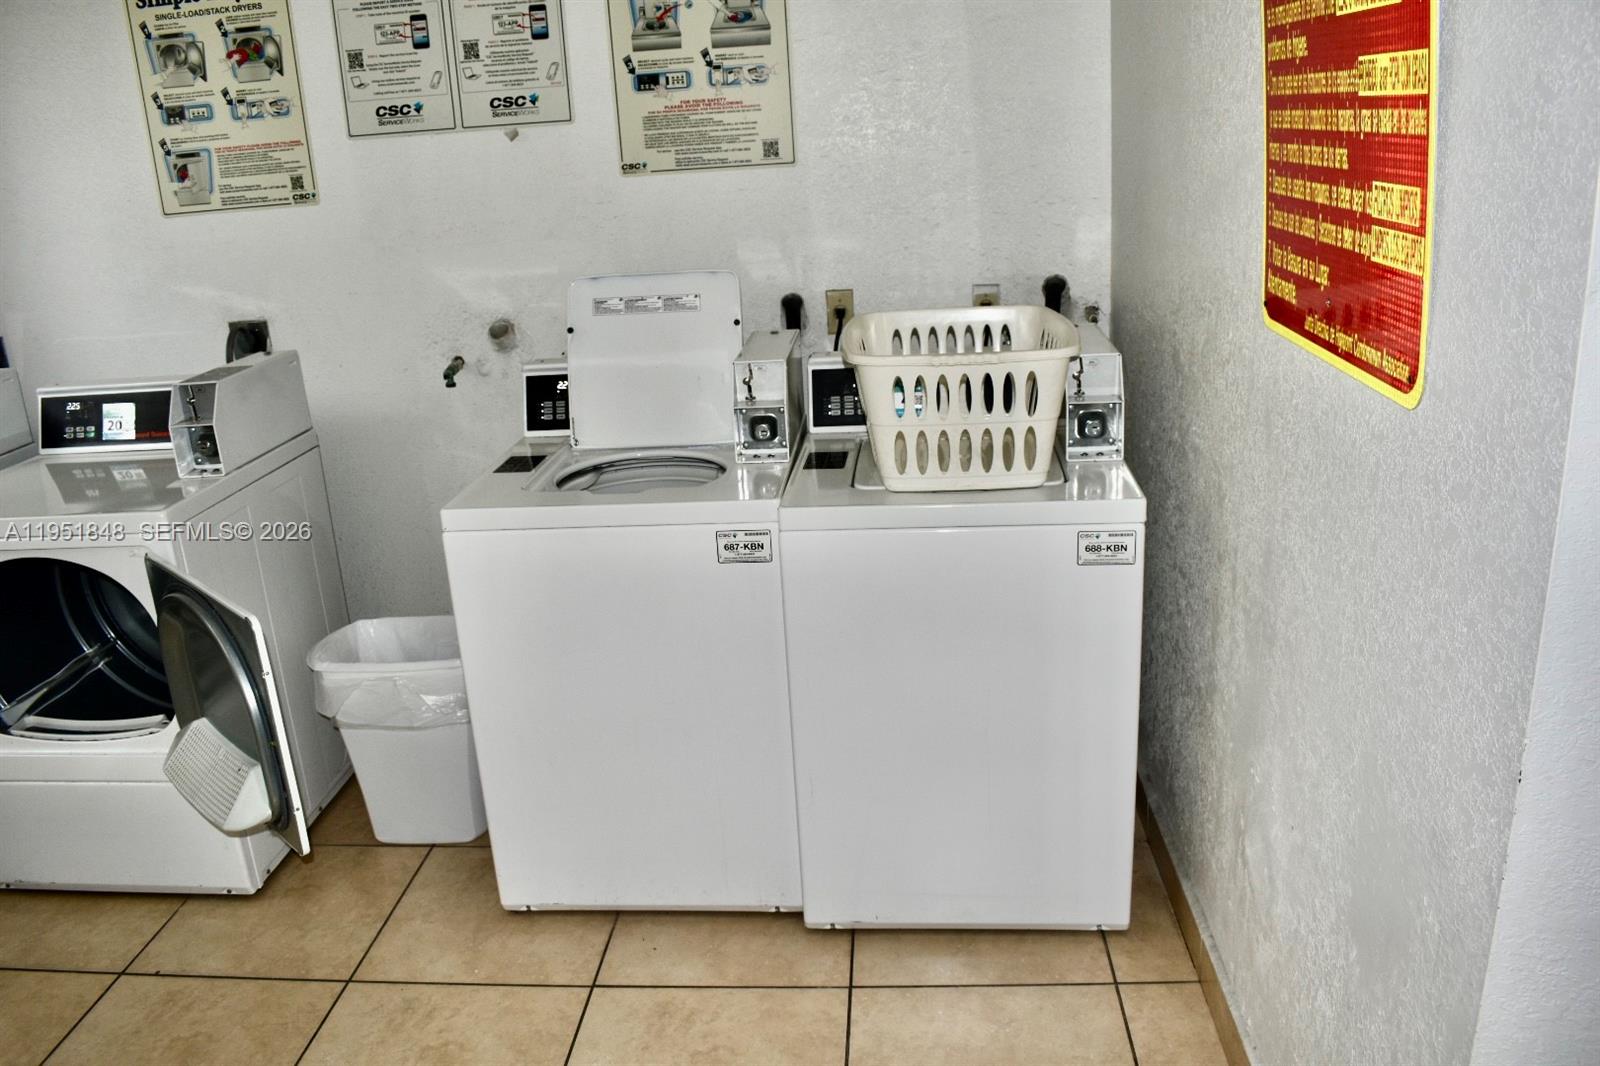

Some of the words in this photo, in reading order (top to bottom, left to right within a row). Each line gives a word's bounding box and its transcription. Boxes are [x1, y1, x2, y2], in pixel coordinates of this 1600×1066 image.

[155, 6, 230, 21] SINGLE-LOAD/STACK
[232, 2, 263, 12] DRYERS
[490, 96, 527, 108] CSC
[376, 104, 411, 117] CSC
[724, 543, 764, 551] 687-KBN
